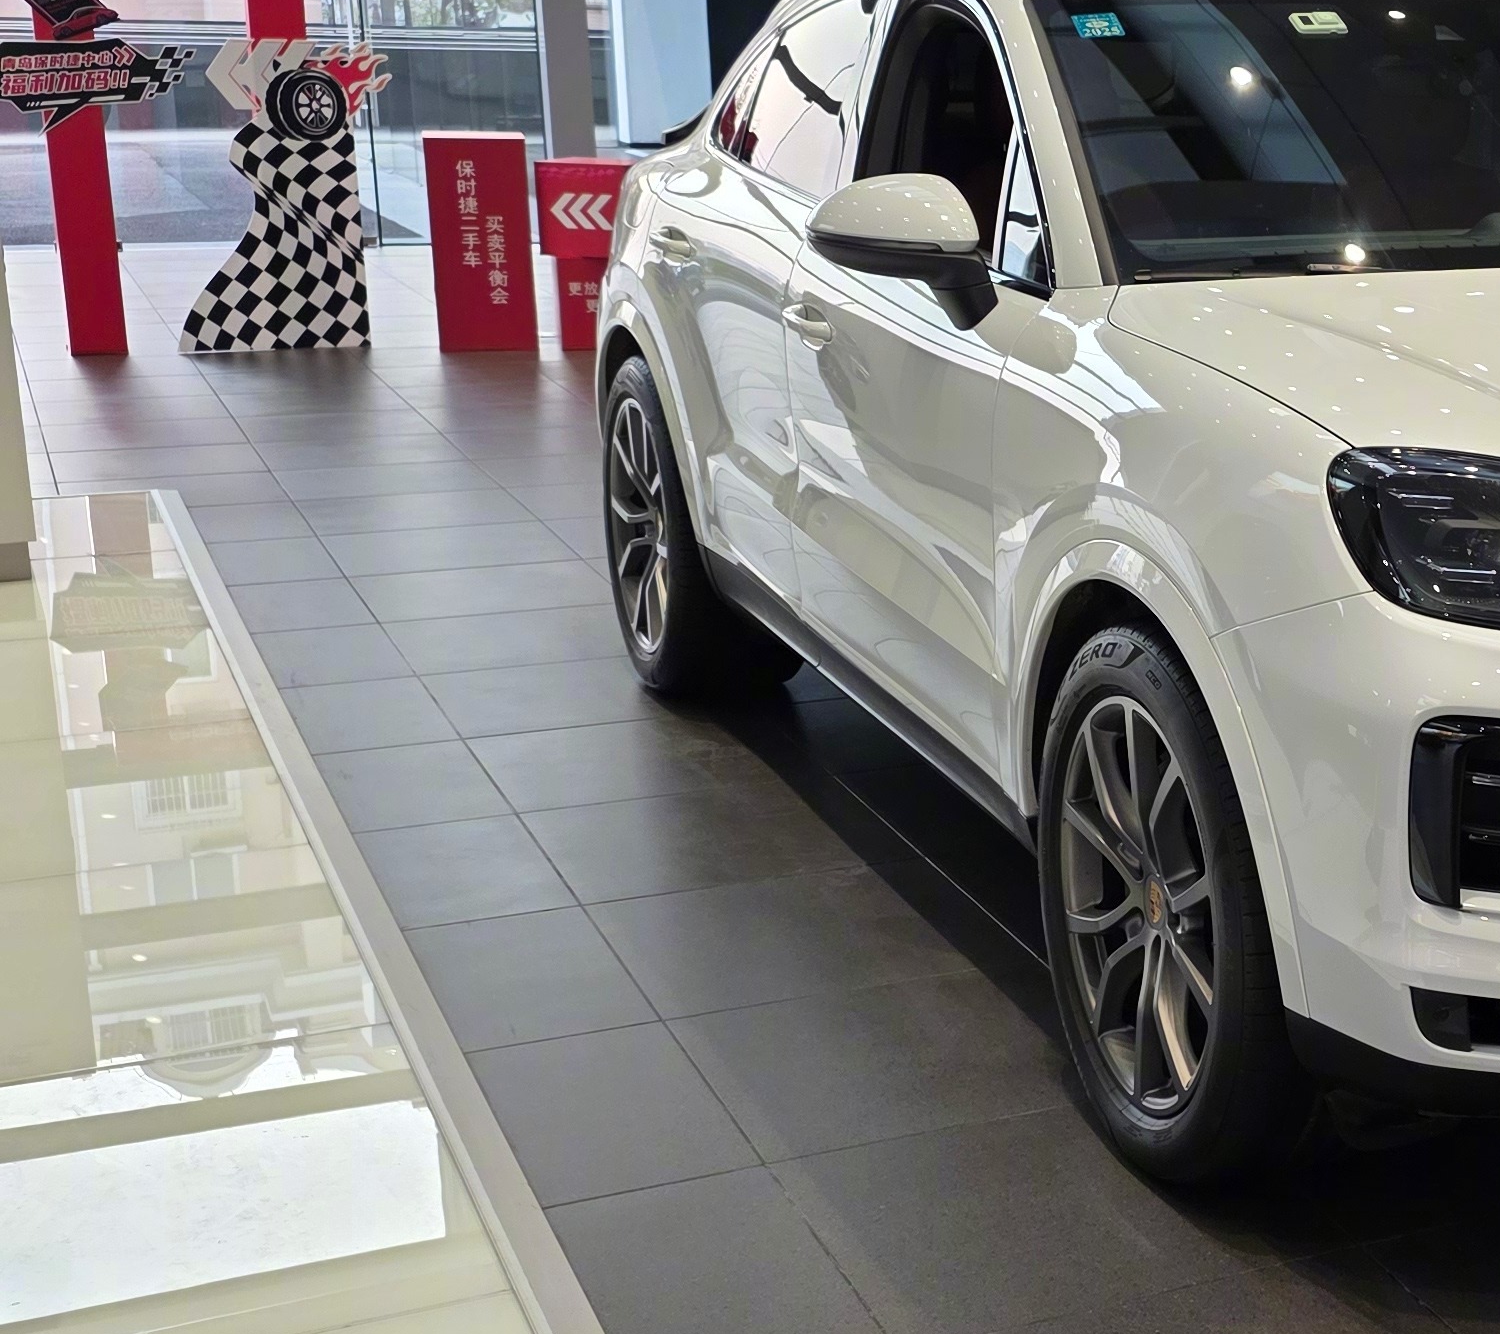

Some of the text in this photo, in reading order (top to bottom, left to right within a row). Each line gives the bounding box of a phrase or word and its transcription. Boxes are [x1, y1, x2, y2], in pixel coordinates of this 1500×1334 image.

[1, 51, 114, 72] 青岛保时捷中心
[455, 160, 483, 268] 保时捷二手车
[485, 215, 510, 305] 买卖平衡会
